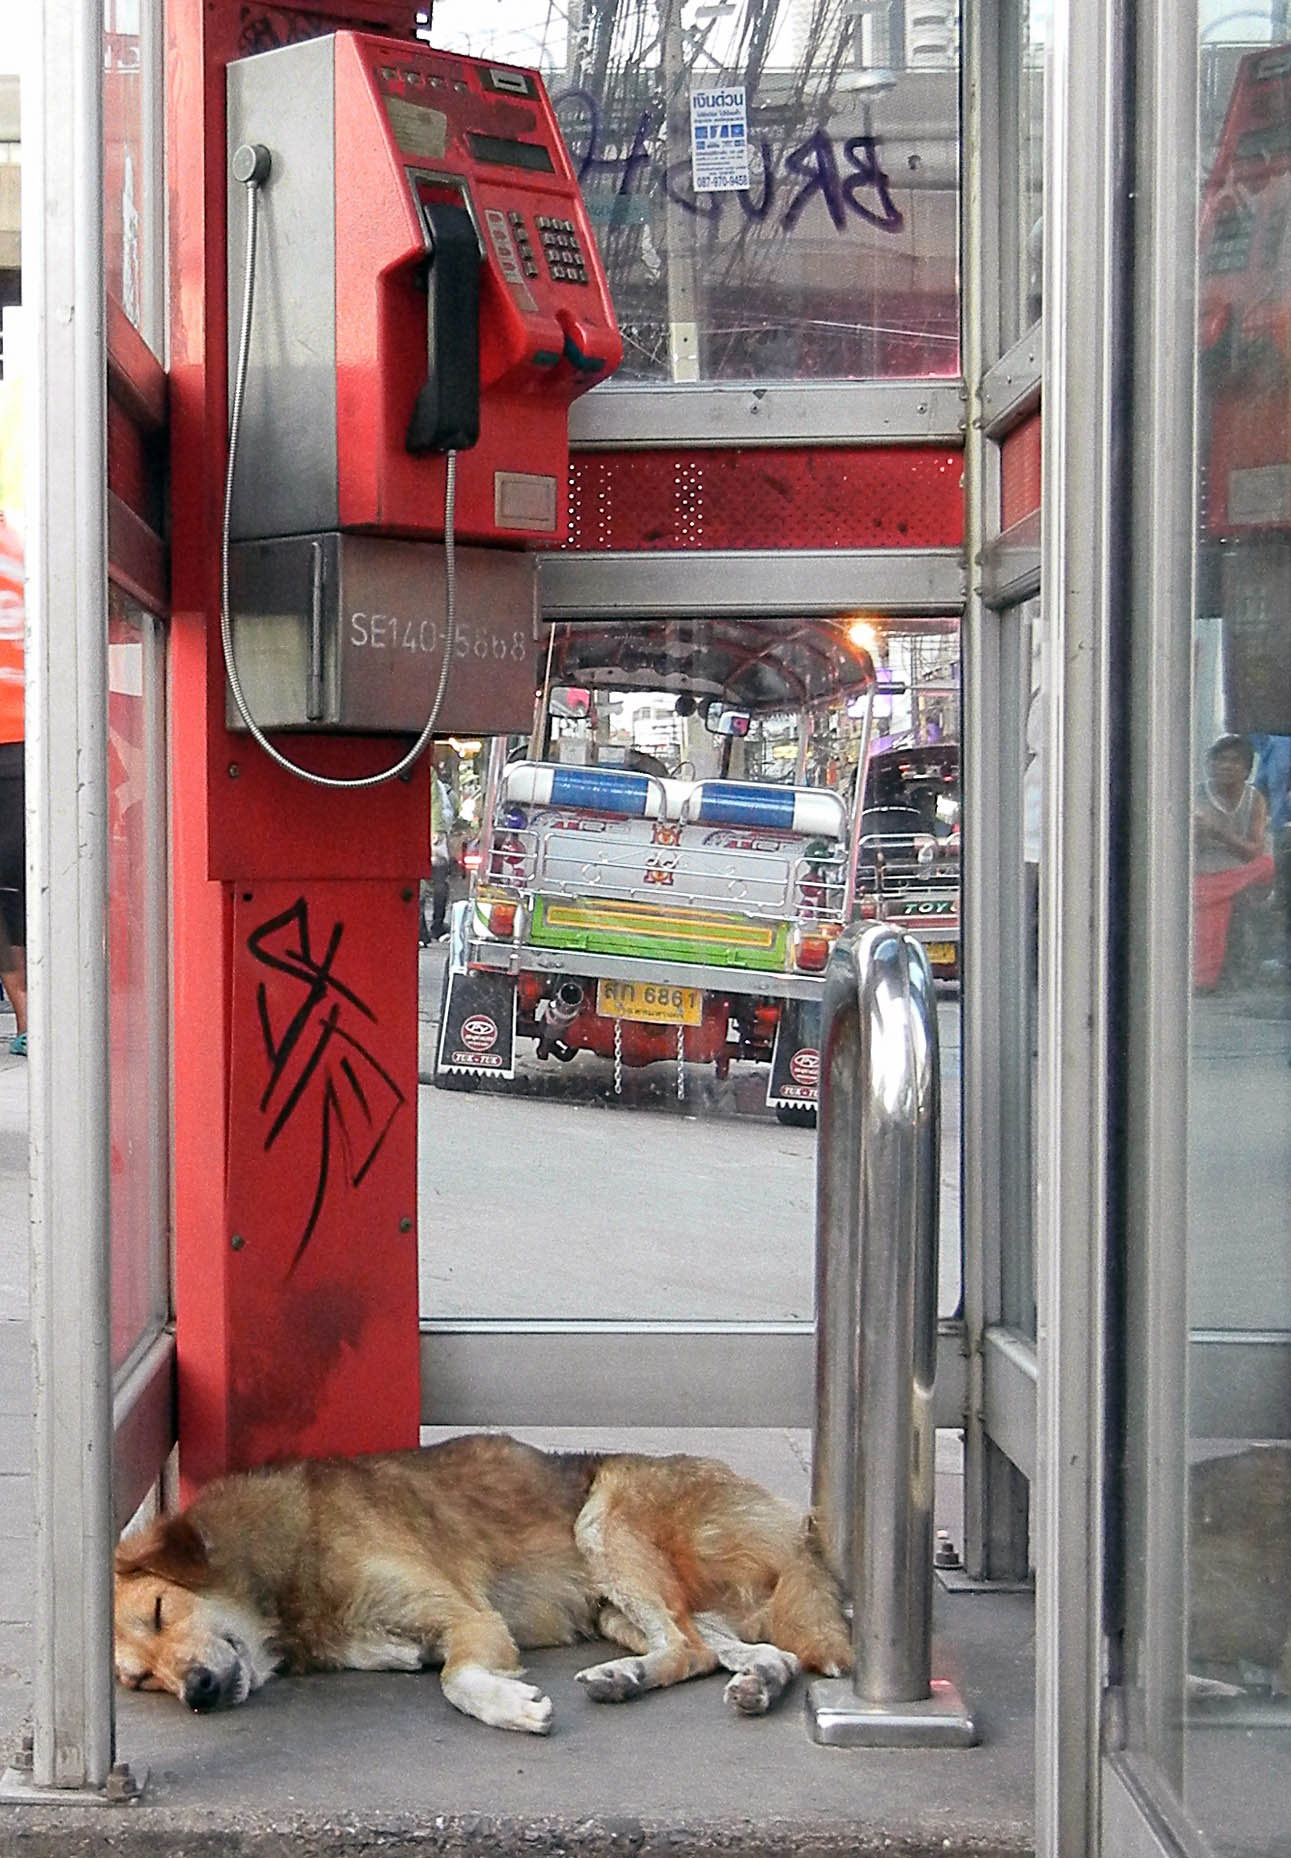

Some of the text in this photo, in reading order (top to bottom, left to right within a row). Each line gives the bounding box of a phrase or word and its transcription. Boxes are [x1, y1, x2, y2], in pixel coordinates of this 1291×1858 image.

[693, 90, 744, 108] เงินด่วน
[644, 987, 696, 1009] 6861
